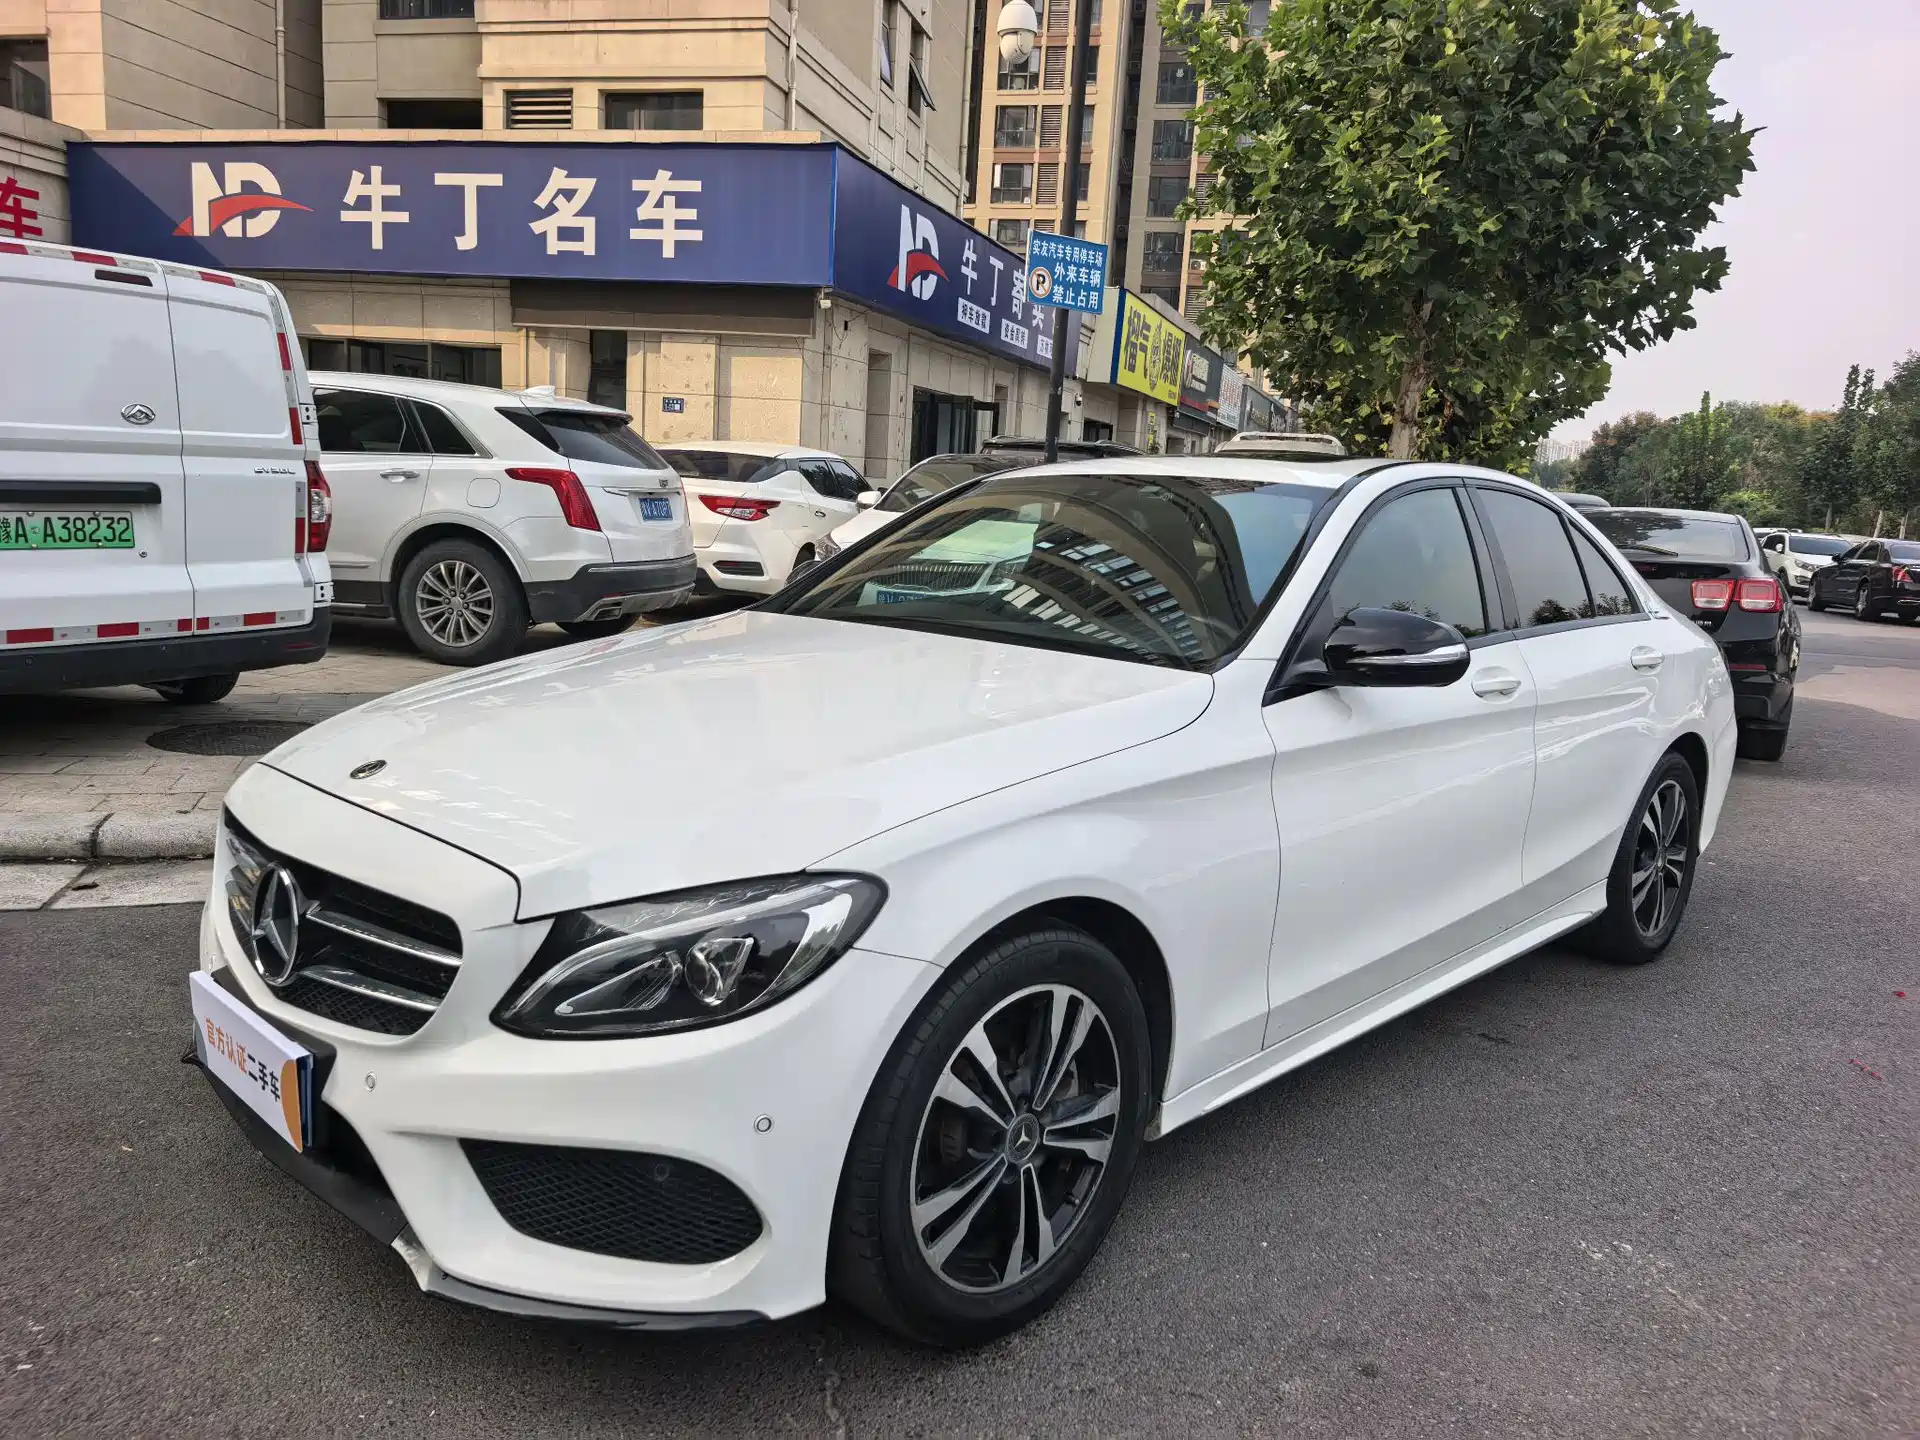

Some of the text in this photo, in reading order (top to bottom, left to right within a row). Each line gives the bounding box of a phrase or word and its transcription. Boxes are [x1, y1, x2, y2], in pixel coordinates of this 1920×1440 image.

[340, 165, 703, 259] 牛丁名车
[1032, 239, 1104, 268] 实友汽车专用停车场
[1054, 262, 1101, 288] 外来车辆
[1052, 284, 1099, 309] 禁止占用
[205, 1016, 281, 1102] 官方认证二手车
